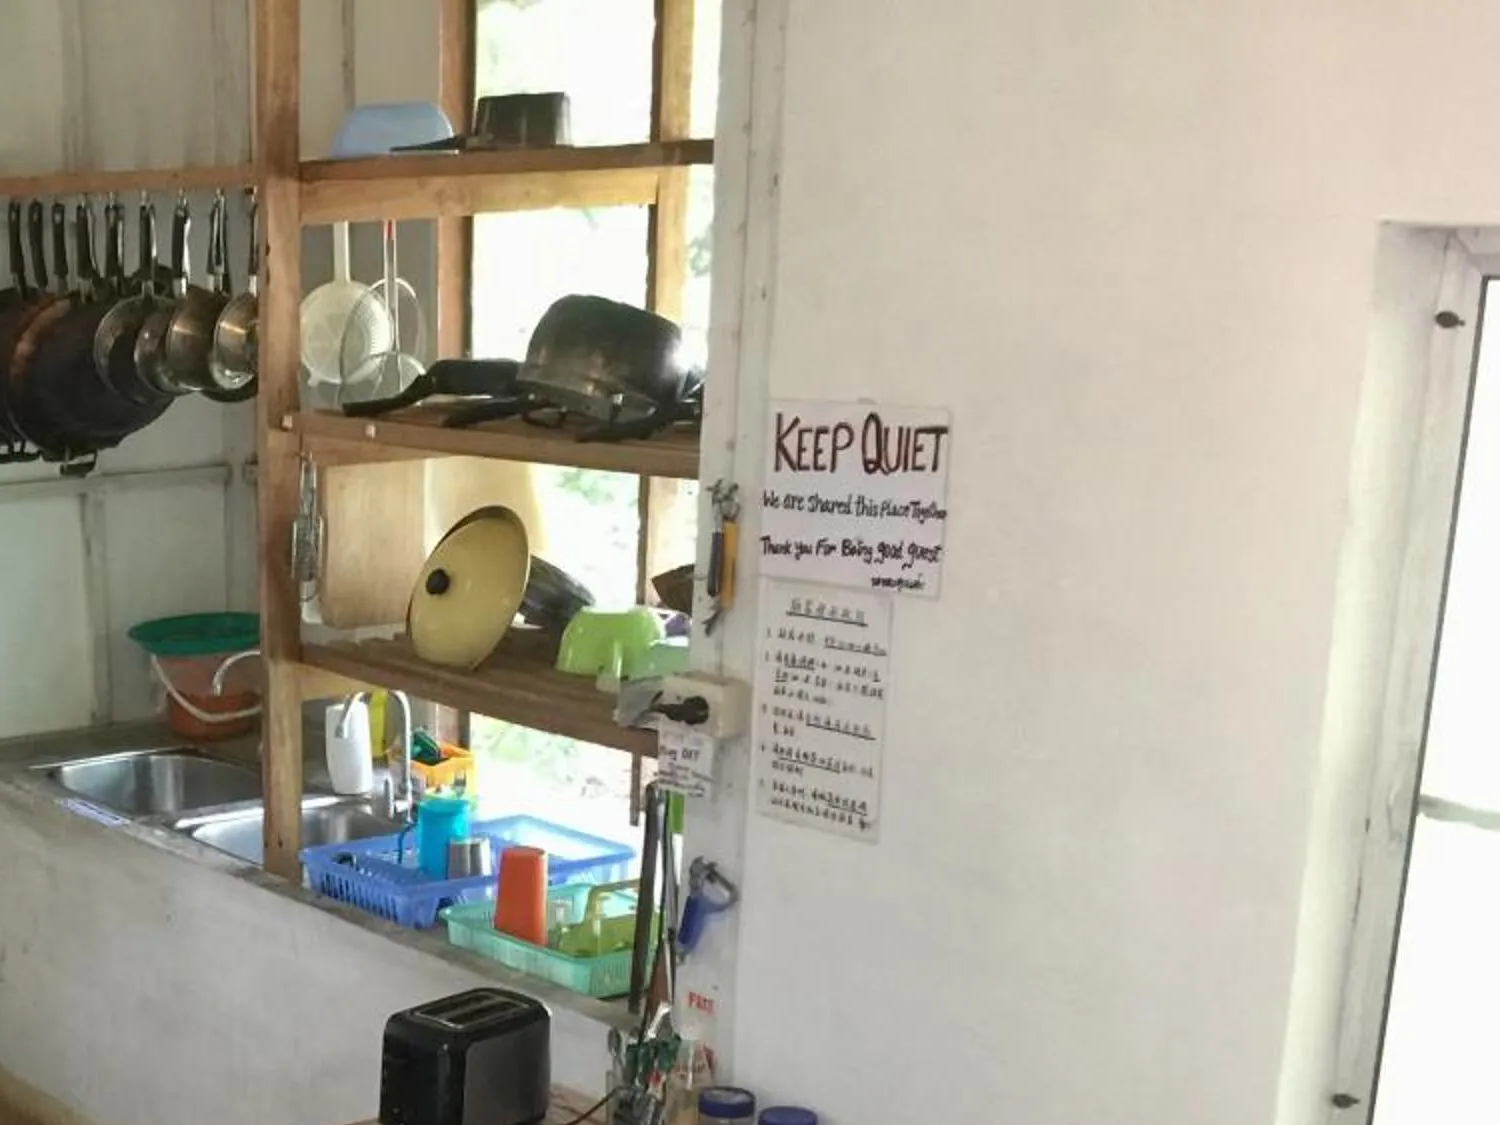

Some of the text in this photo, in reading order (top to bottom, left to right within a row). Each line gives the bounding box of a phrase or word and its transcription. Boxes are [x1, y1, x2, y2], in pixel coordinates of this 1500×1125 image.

[774, 412, 948, 475] KEEP QUIET
[763, 488, 780, 509] We
[783, 493, 805, 511] are
[855, 495, 879, 517] this
[760, 535, 792, 555] Thank
[873, 540, 905, 564] good
